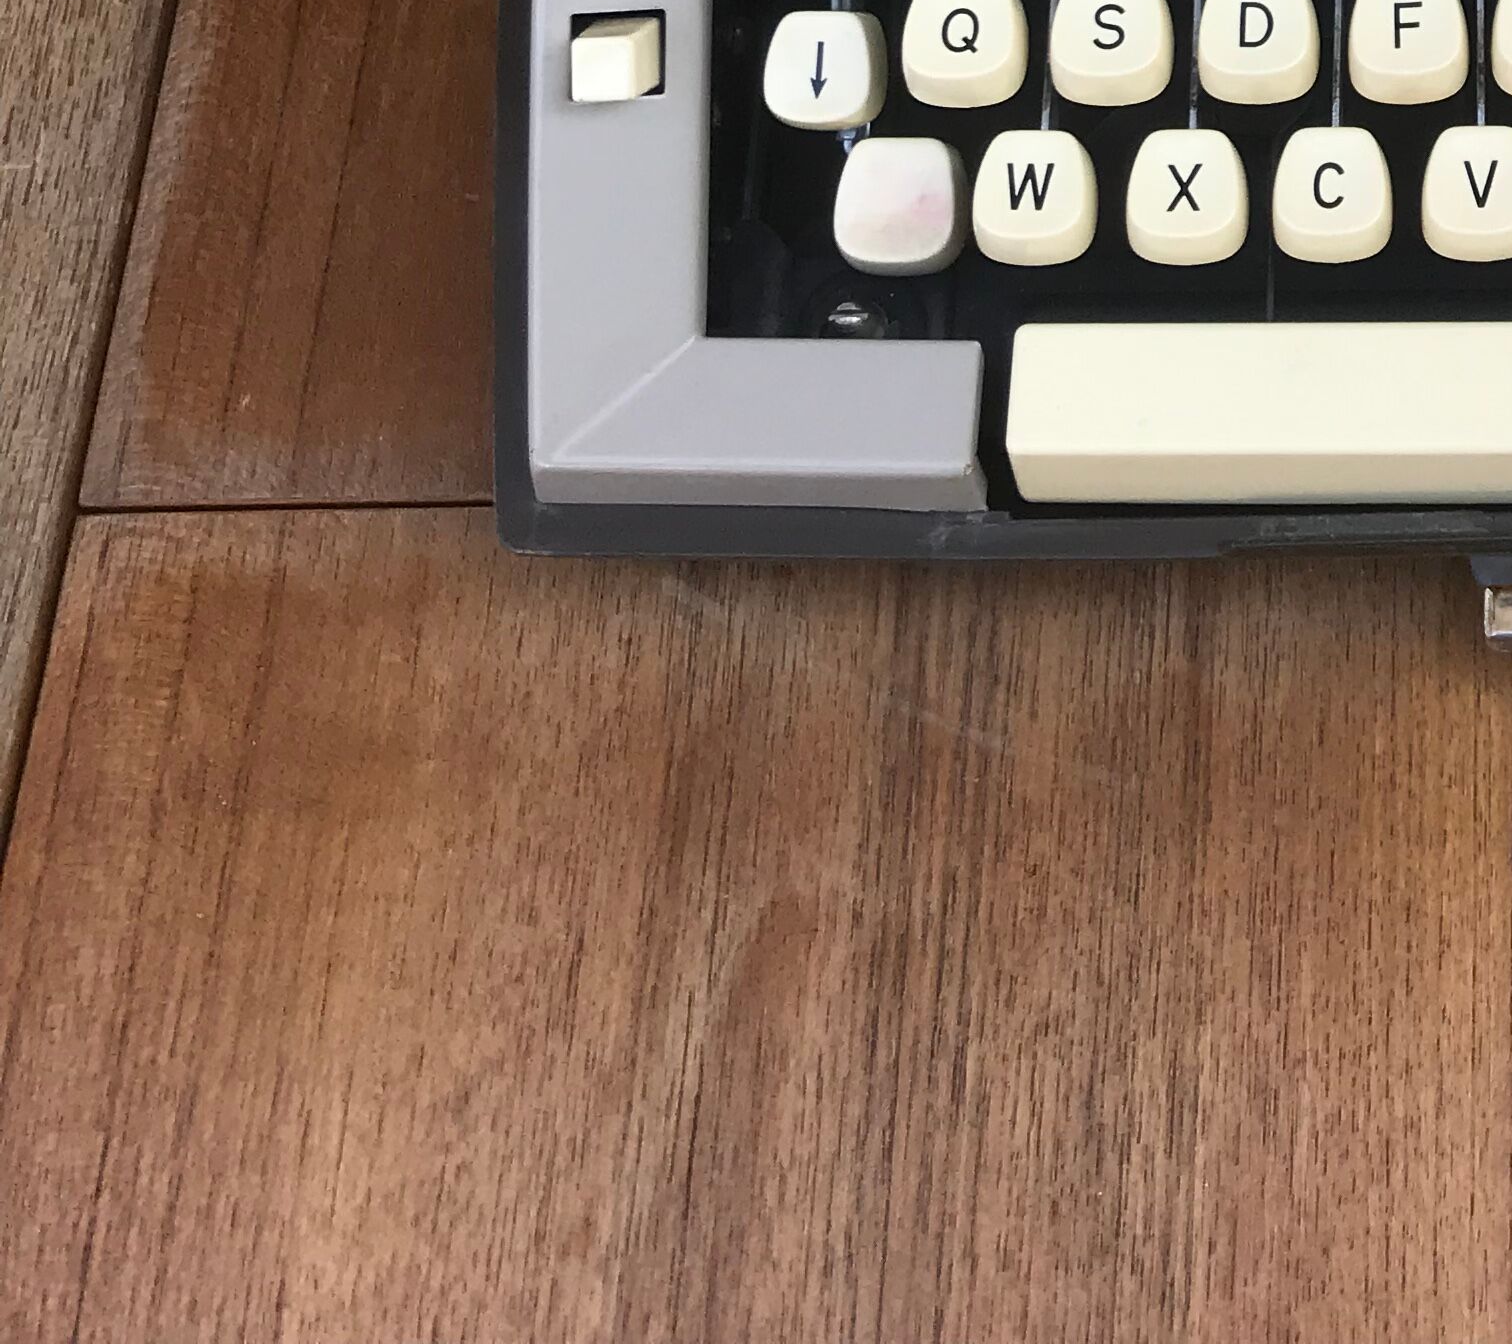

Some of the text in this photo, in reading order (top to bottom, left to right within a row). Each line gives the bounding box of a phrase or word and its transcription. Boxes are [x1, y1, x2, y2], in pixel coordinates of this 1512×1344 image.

[941, 7, 980, 54] Q
[1093, 3, 1125, 50] S
[1239, 1, 1274, 48] D
[1393, 1, 1423, 49] F
[1007, 162, 1055, 211] W
[1166, 163, 1203, 212] X
[1313, 161, 1345, 209] C
[1463, 160, 1498, 209] V
